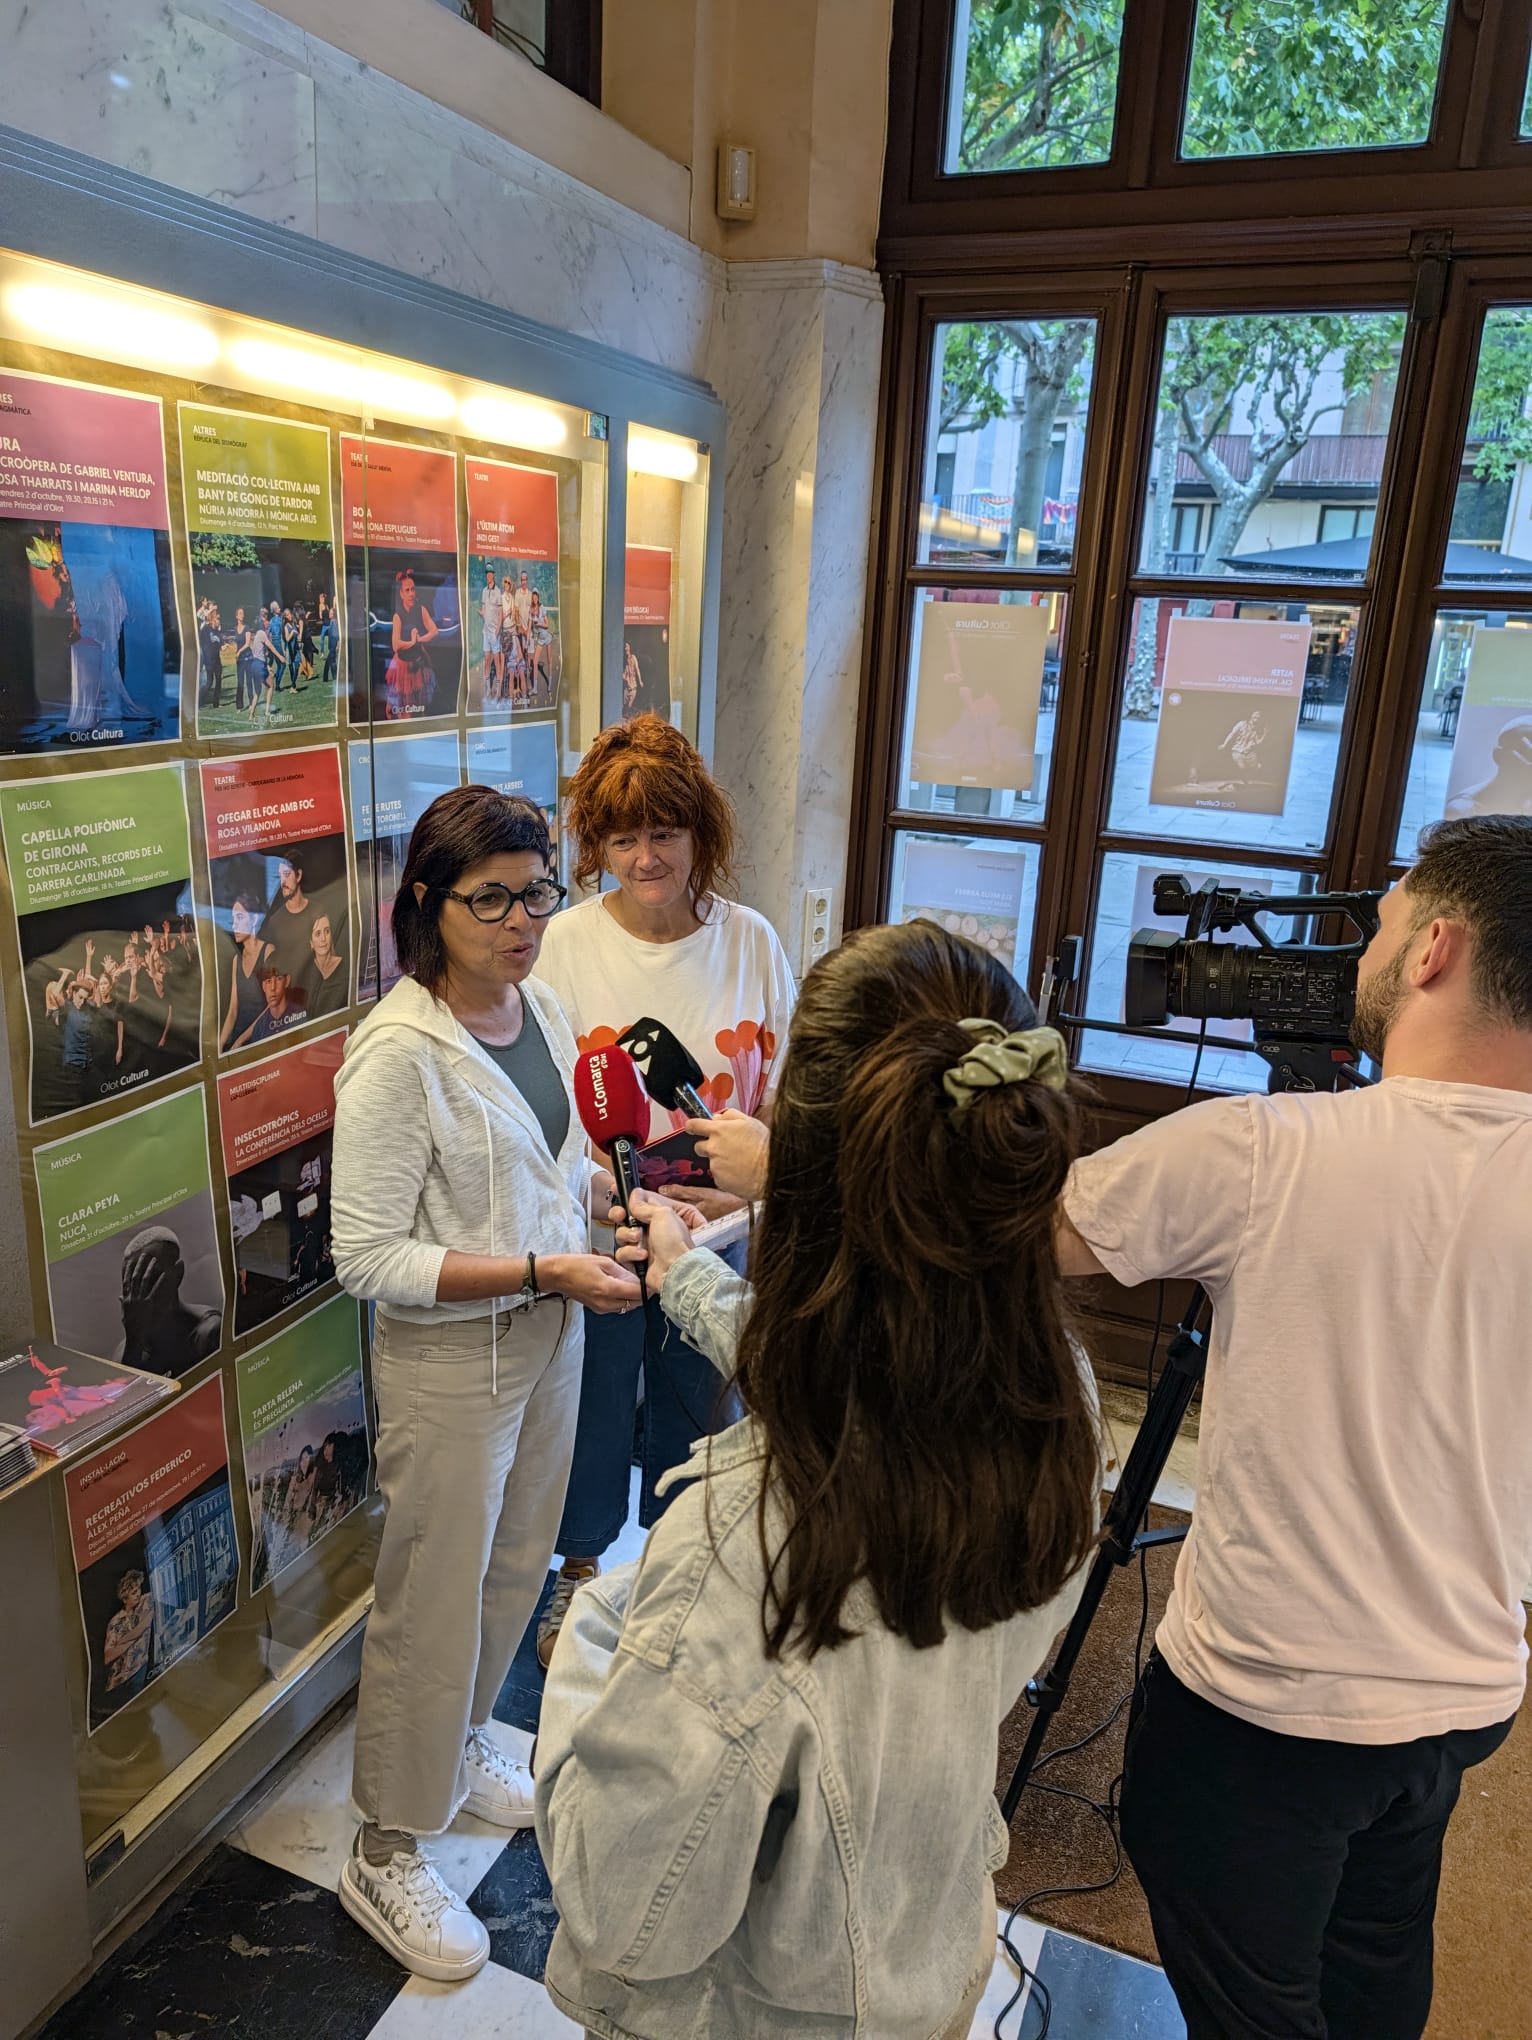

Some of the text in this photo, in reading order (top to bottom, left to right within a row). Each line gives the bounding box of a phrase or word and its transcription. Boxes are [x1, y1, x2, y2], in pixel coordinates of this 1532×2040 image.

[0, 436, 21, 451] RA
[350, 452, 368, 462] TEATE
[60, 463, 72, 474] DE
[74, 465, 112, 480] GABRIEL
[113, 469, 155, 486] VENTURA,
[196, 470, 249, 486] MEDITACIÓ
[303, 483, 320, 495] AMB
[21, 475, 72, 491] THARRATS
[80, 483, 117, 496] MARINA
[119, 487, 151, 499] HERLOP
[198, 488, 313, 510] BANY DE GONG DE TARDOR
[199, 503, 225, 516] NÚRIA
[352, 506, 372, 518] BOA
[352, 521, 384, 532] MAIONA
[405, 703, 424, 713] Cultura
[70, 728, 123, 743] Olot Cultura
[17, 799, 52, 812] MÚSICA
[217, 798, 315, 825] OFEGAR EL FOC AMB FOC
[21, 816, 136, 845] CAPELLA POLIFÒNICA
[218, 820, 281, 839] ROSA VILANOVA
[24, 842, 88, 863] DE GIRONA
[25, 845, 163, 879] CONTRACANTS, RECORDS DE LA
[28, 867, 126, 894] DARRERA CARLINADA
[284, 1010, 307, 1024] Cultura
[100, 1069, 149, 1093] Olot Cultura
[235, 1148, 244, 1158] LA
[291, 1120, 306, 1132] DELS
[306, 1109, 328, 1125] OCELLS
[51, 1153, 82, 1171] MÚSICA
[58, 1193, 120, 1228] CLARA PEYA
[60, 1223, 87, 1242] NUCA
[252, 1398, 276, 1419] TARTA
[276, 1379, 304, 1404] RELENA
[85, 1478, 150, 1529] RECREATIVOS
[150, 1449, 192, 1484] FEDERICO
[109, 1506, 131, 1526] PEÑA
